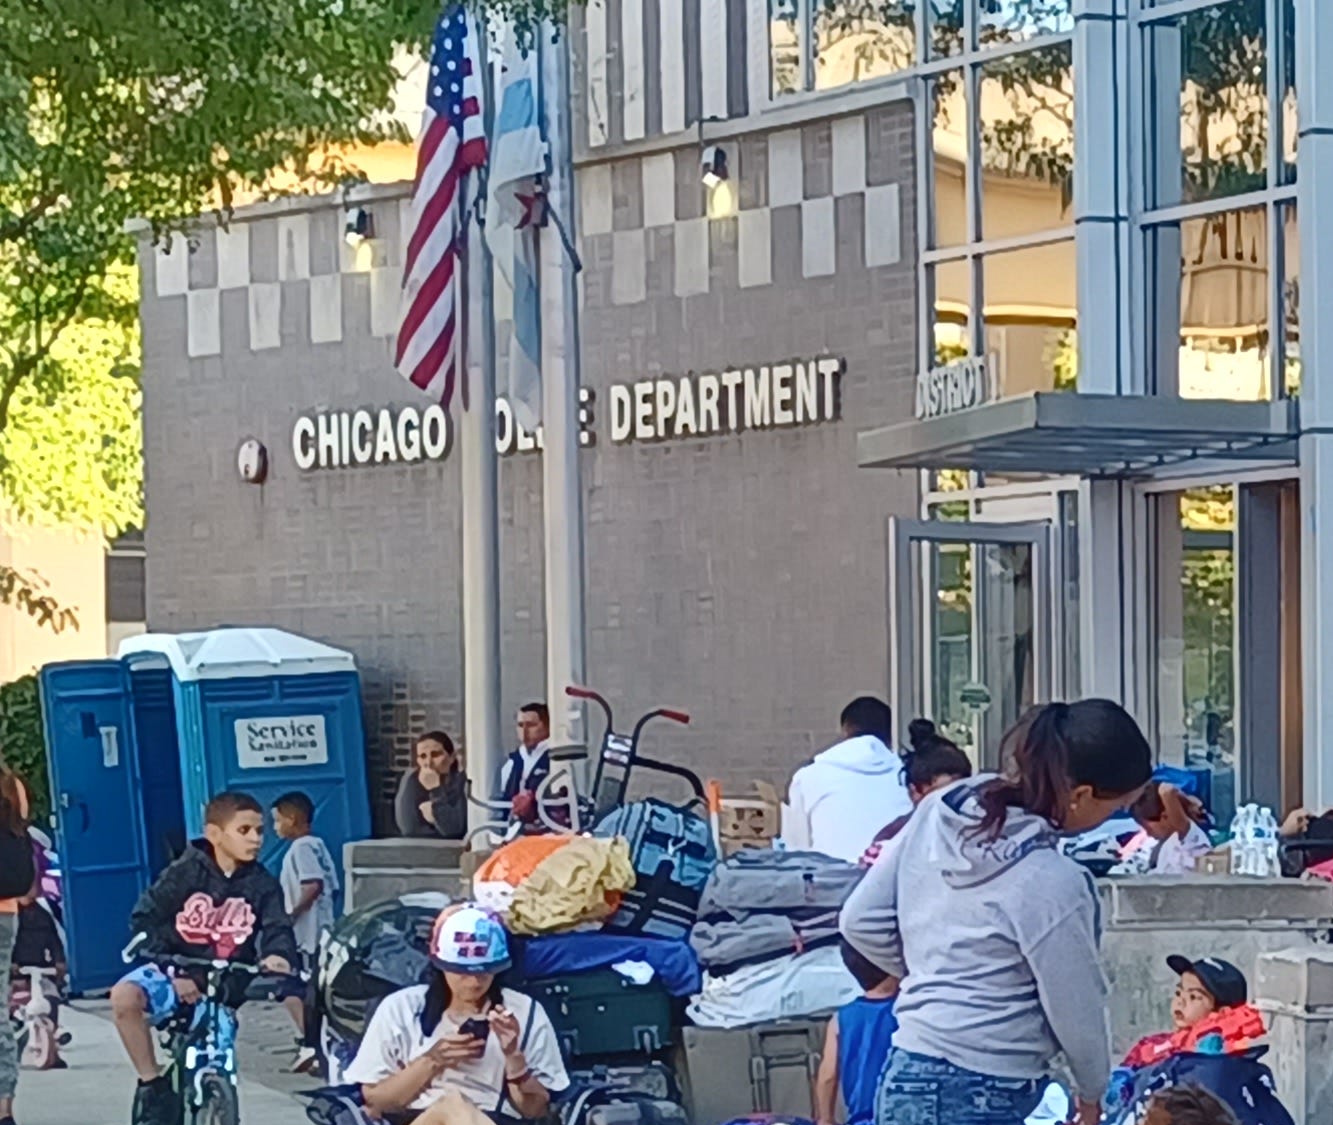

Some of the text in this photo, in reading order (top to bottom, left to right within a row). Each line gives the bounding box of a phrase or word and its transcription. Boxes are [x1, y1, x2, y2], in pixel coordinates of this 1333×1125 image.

[293, 404, 447, 469] CHICAGO
[610, 358, 839, 441] DEPARTMENT
[247, 720, 316, 739] Service
